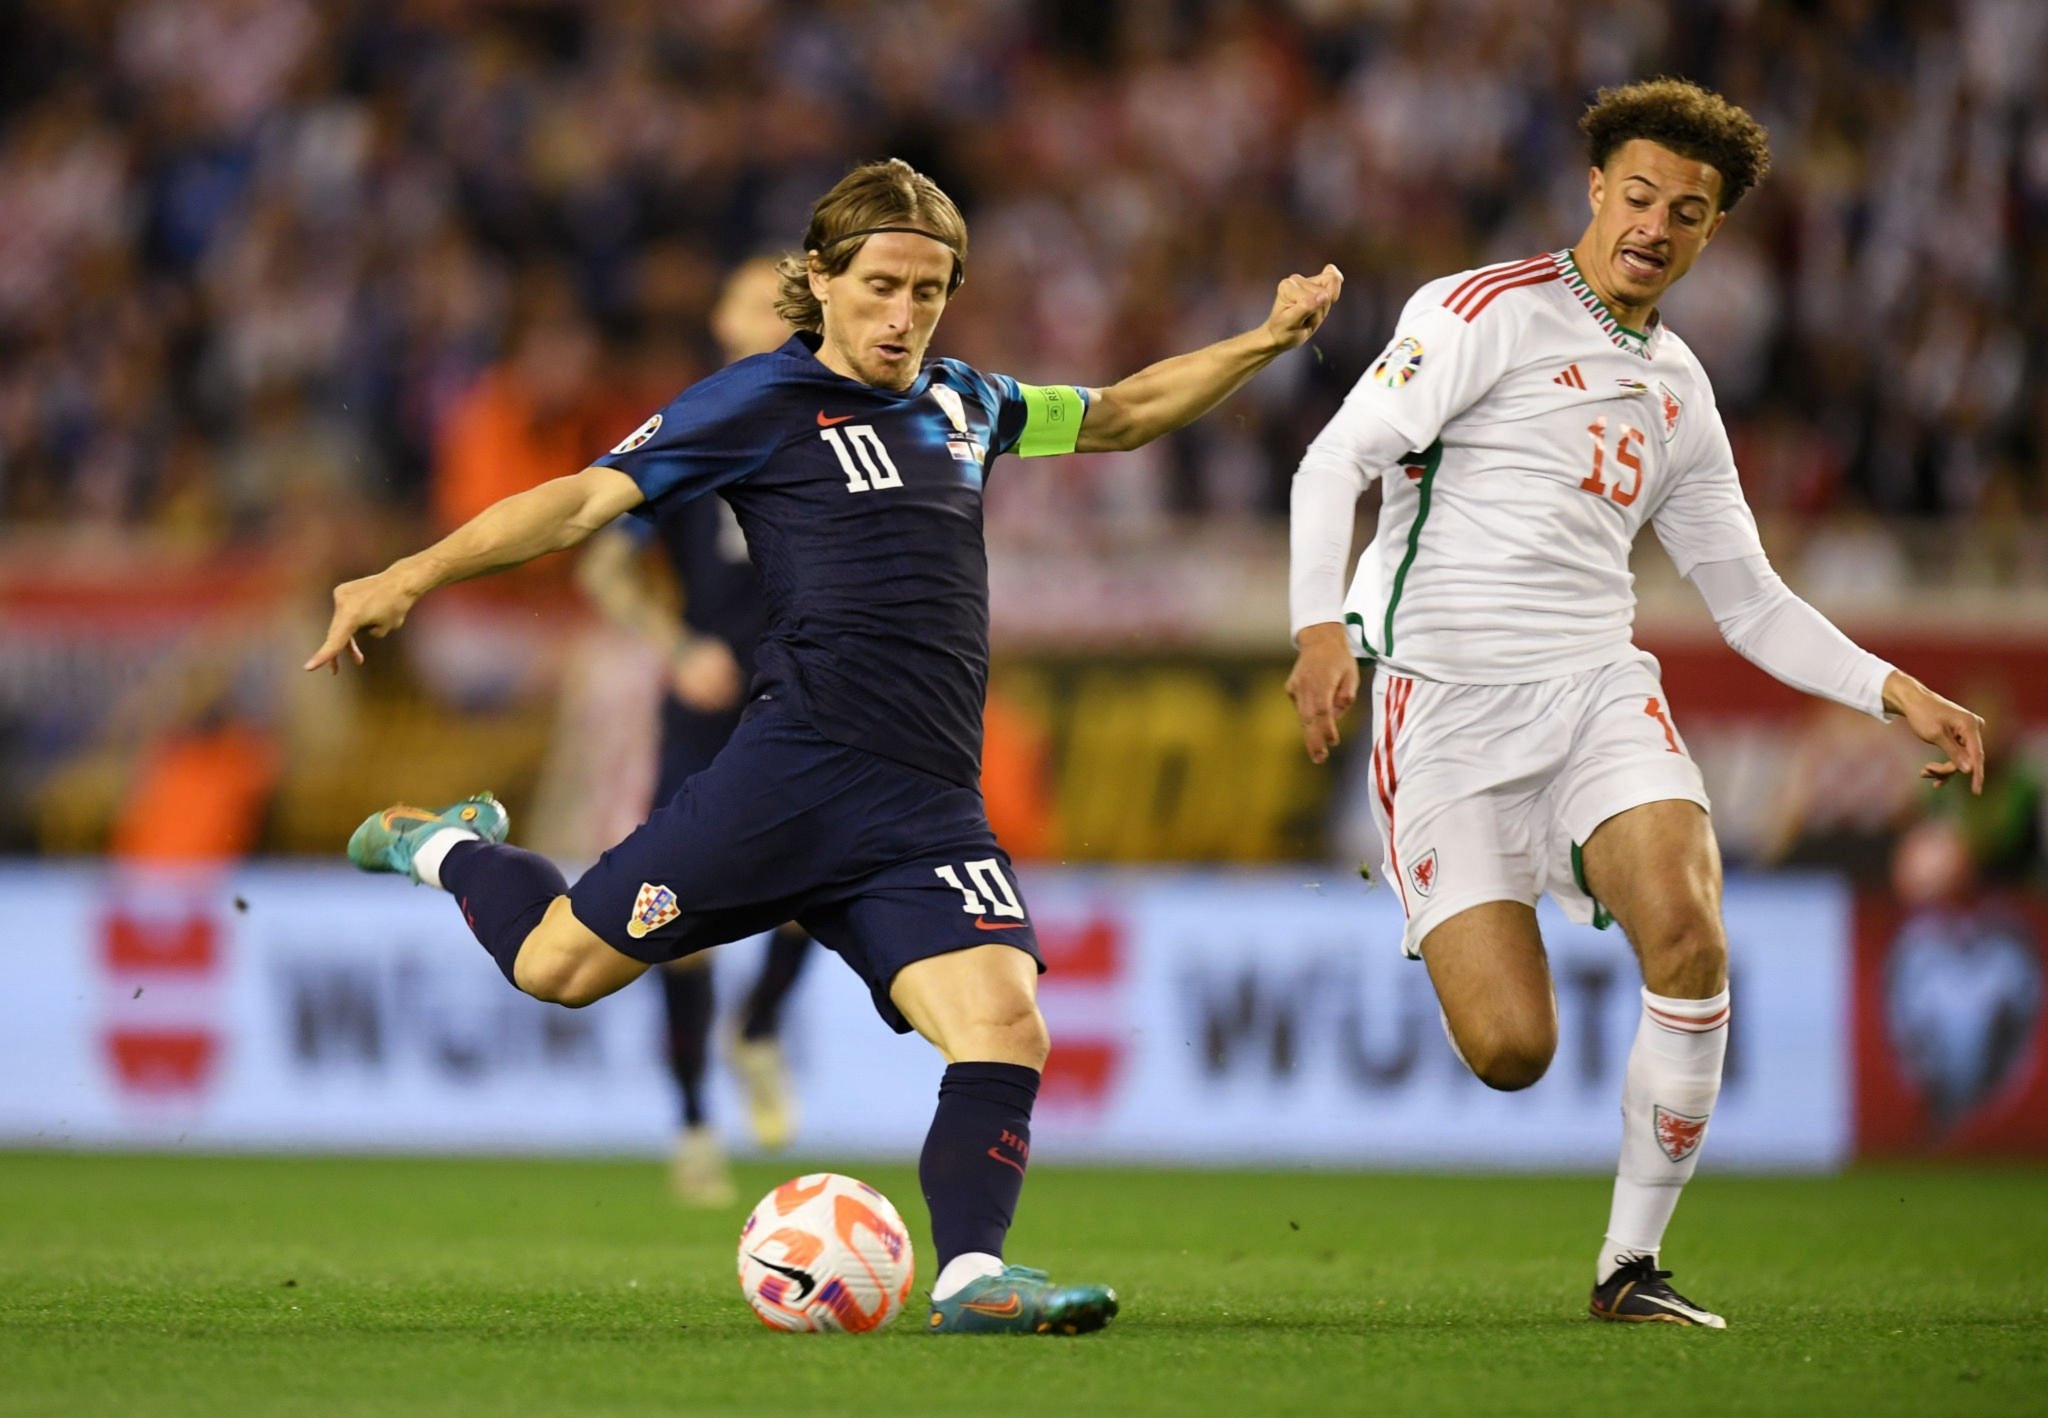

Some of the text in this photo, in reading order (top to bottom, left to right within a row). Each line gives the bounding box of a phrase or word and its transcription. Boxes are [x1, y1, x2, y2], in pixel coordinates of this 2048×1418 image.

[820, 425, 903, 492] 10
[1580, 416, 1646, 507] 15
[934, 858, 1024, 919] 10
